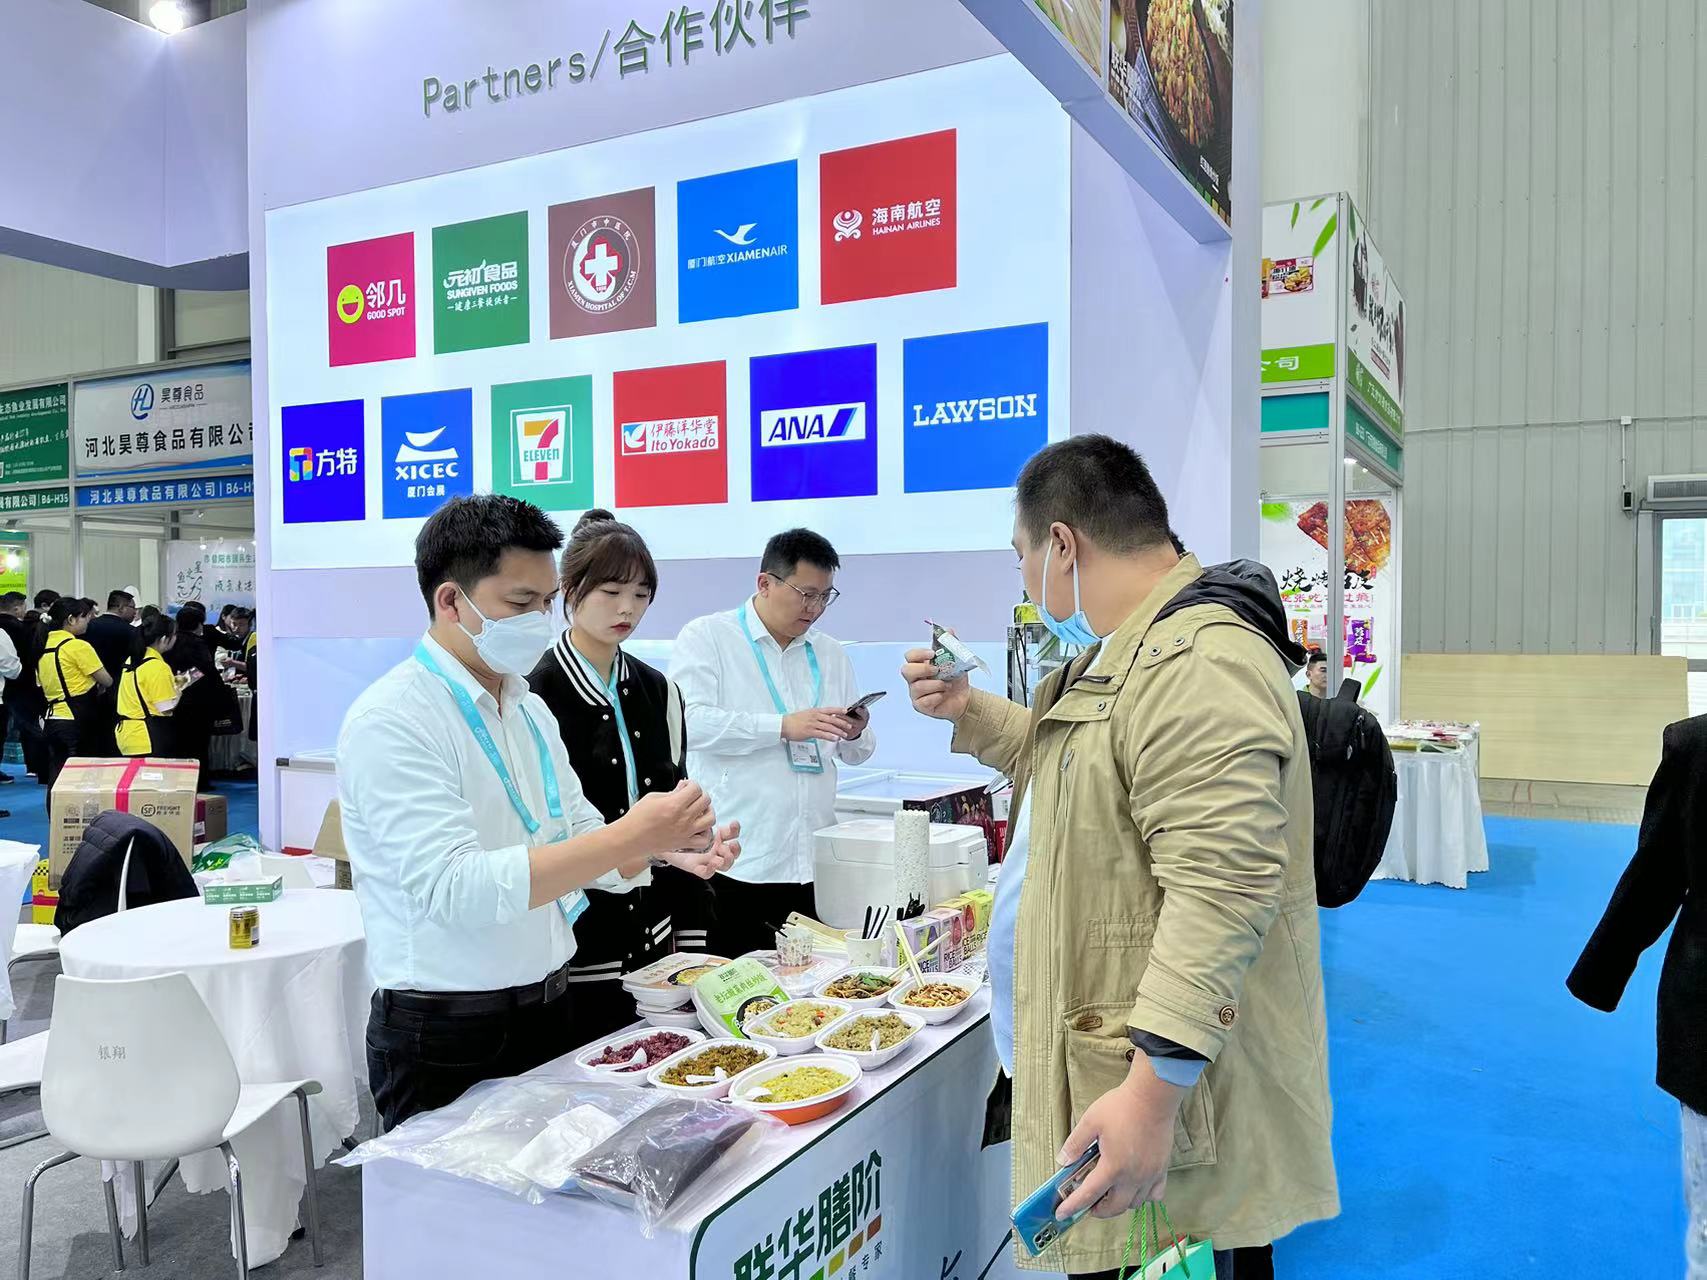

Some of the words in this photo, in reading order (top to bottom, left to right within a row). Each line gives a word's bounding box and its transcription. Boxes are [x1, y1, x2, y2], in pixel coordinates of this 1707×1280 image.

[871, 198, 941, 227] 海南航空
[872, 223, 905, 236] HAINAN
[906, 216, 941, 230] AIRLINES
[443, 258, 518, 289] 元初食品
[365, 279, 406, 309] 邻几
[446, 286, 488, 300] SUNGIVEN
[489, 279, 518, 294] FOODS
[567, 280, 587, 306] XIAMEN
[585, 297, 618, 311] HOSPITAL
[615, 290, 626, 304] OF
[366, 310, 387, 321] GOOD
[387, 305, 406, 318] SPOT
[161, 383, 204, 403] 昊尊食品
[913, 393, 1038, 428] LAWSON
[650, 418, 716, 439] 伊藤洋华堂
[767, 415, 825, 442] ANA
[650, 438, 668, 451] Ito
[668, 436, 716, 450] Yokado
[316, 447, 358, 477] 方特
[395, 462, 459, 482] XICEC
[89, 481, 215, 505] 河北昊尊食品有限公司
[226, 479, 254, 495] B6-H
[407, 484, 446, 499] 厦门会展
[97, 1045, 126, 1060] 银翔
